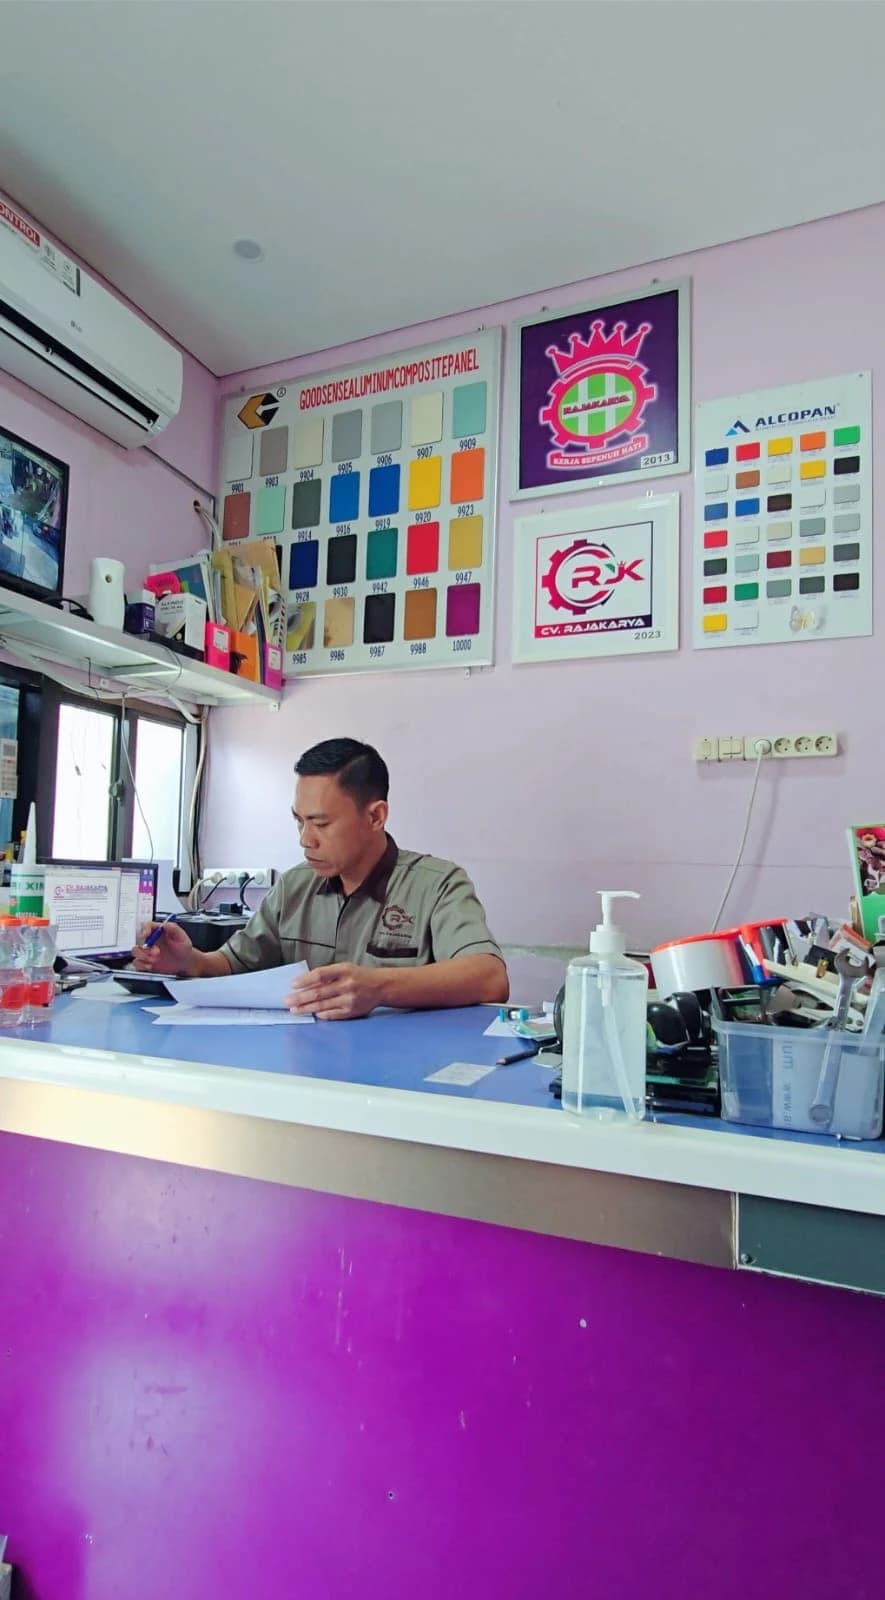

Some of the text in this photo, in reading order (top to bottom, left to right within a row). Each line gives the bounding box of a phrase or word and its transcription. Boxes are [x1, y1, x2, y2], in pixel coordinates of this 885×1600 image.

[299, 348, 479, 410] GOODSENSEALUMINUMCOMPOSITEPANEL
[755, 404, 836, 428] ALCOPAN
[299, 469, 314, 481] 9904
[337, 462, 353, 474] 9905
[376, 454, 392, 466] 9906
[416, 446, 433, 459] 9907
[459, 438, 476, 450] 9909
[643, 453, 670, 465] 2013
[335, 524, 351, 536] 9916
[375, 517, 391, 530] 9919
[415, 511, 431, 524] 9920
[457, 504, 474, 517] 9923
[332, 586, 348, 598] 9930
[372, 581, 388, 593] 9942
[413, 576, 429, 589] 9946
[455, 571, 472, 584] 9947
[540, 617, 646, 636] CV. RAJAKARYA
[634, 630, 662, 641] 2023
[329, 649, 345, 662] 9986
[369, 645, 385, 658] 9987
[452, 639, 472, 652] 10000
